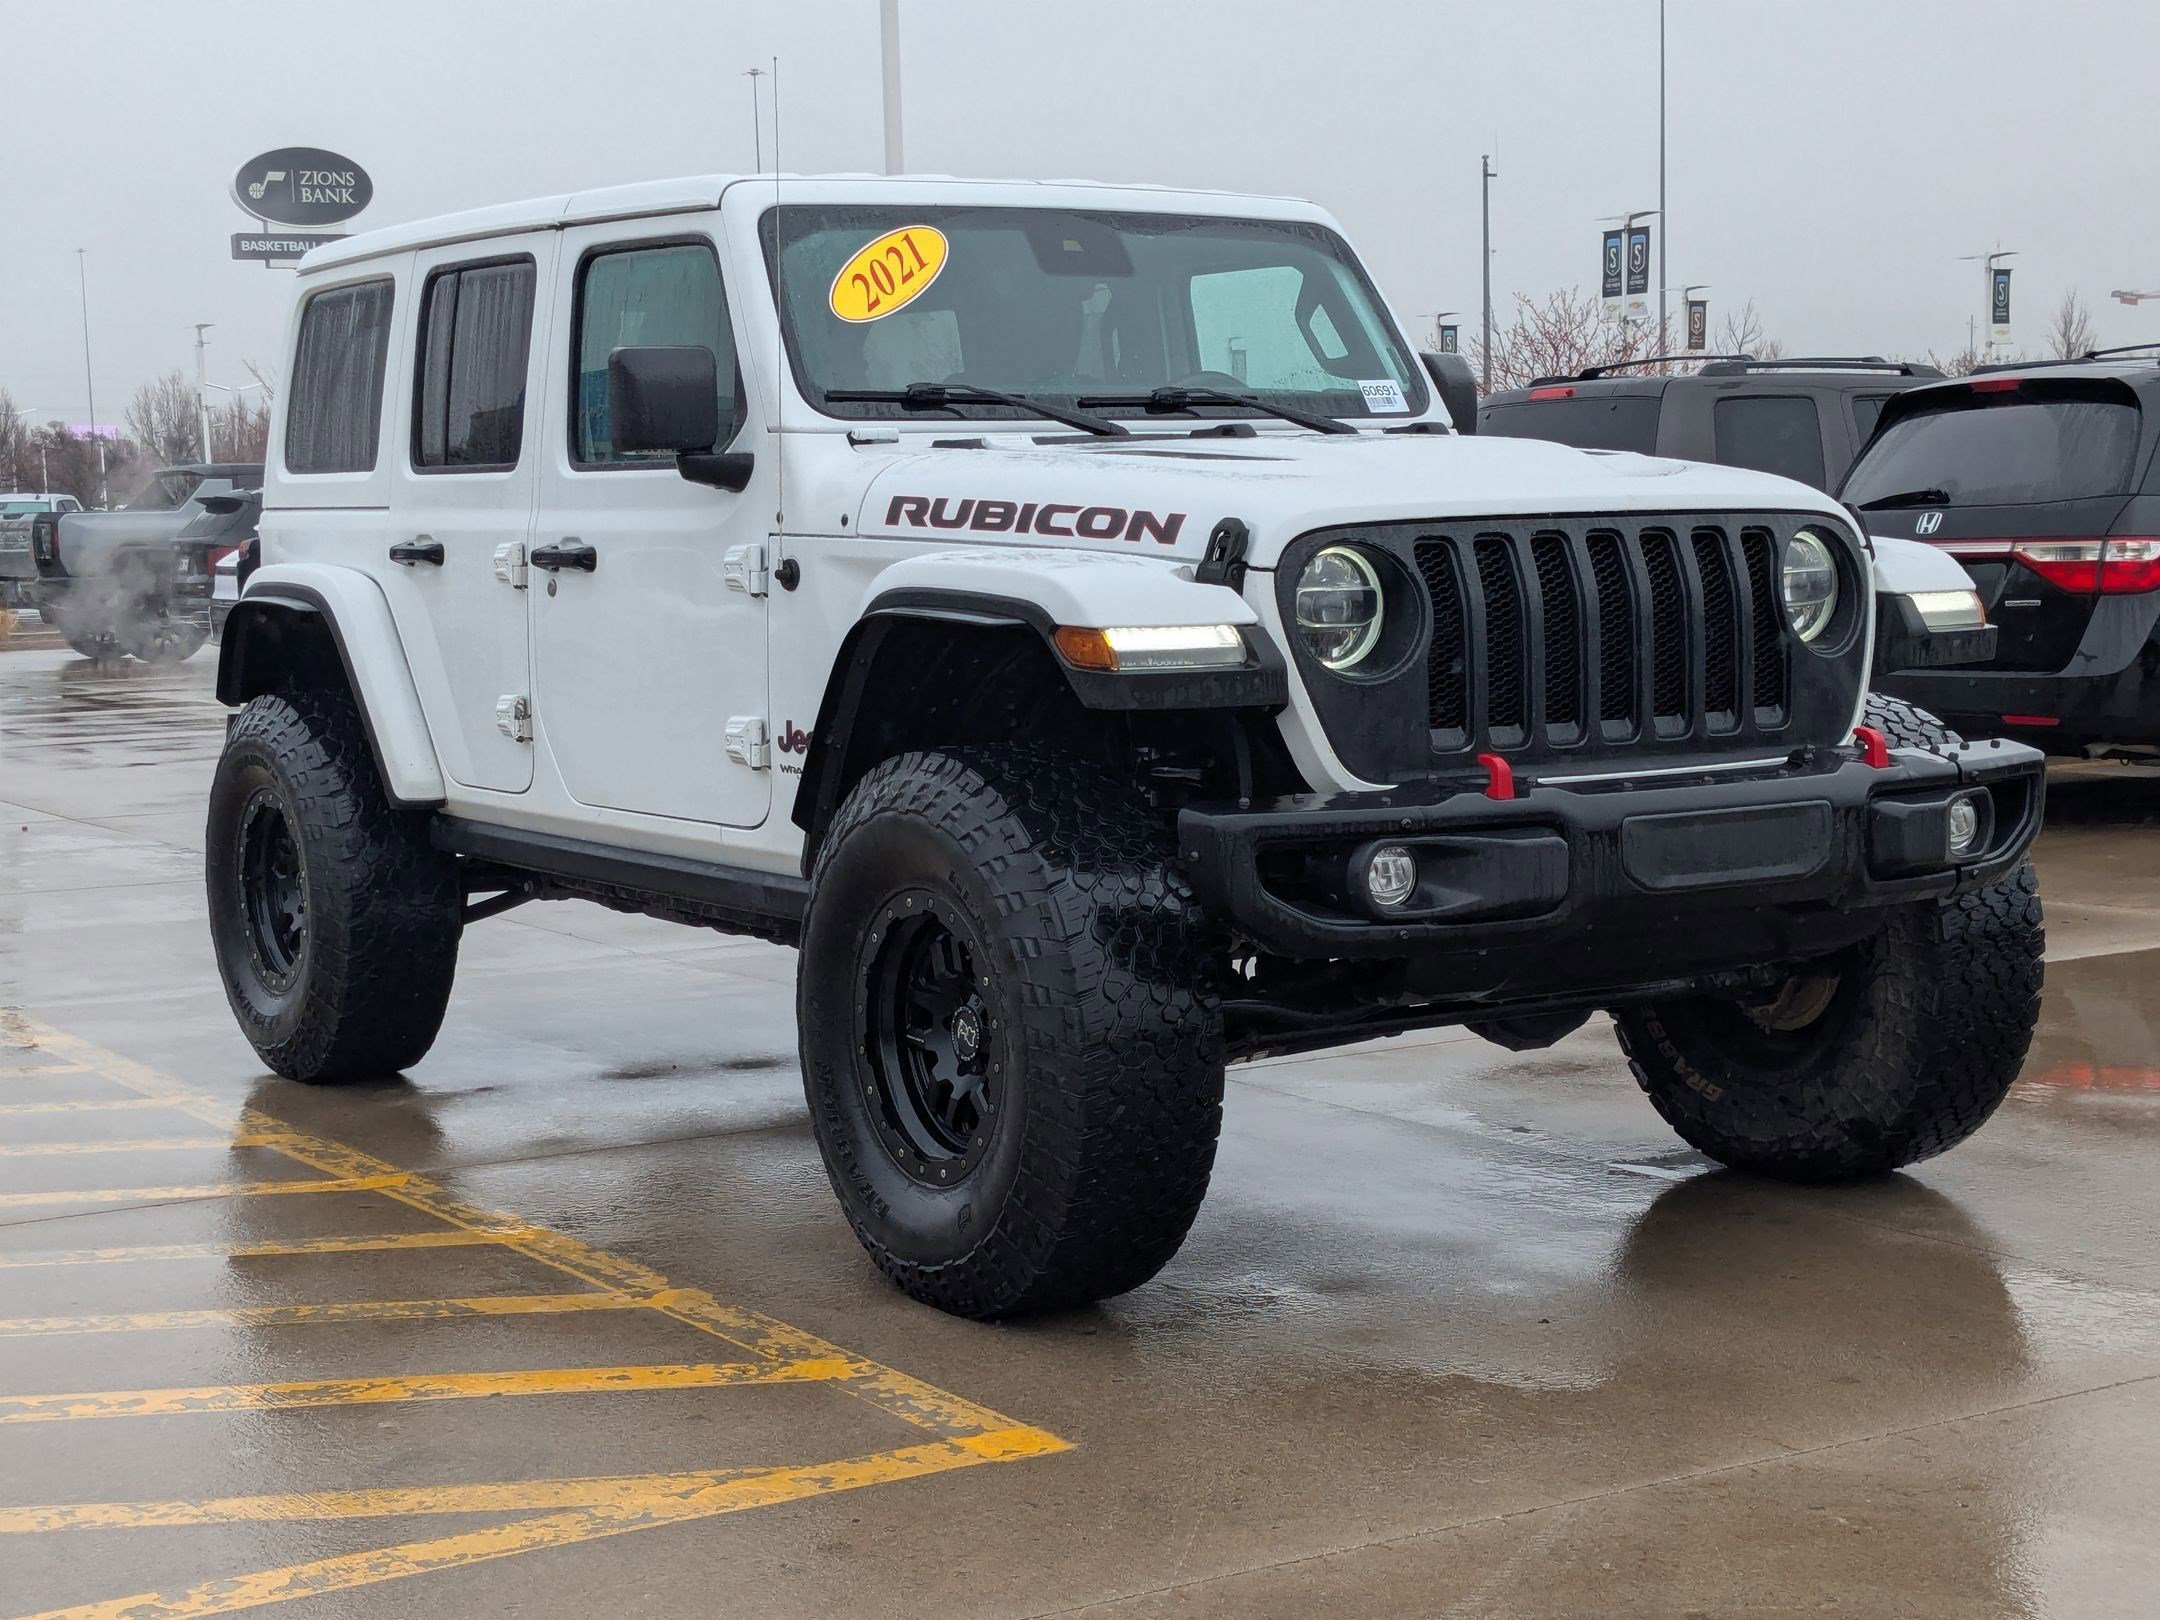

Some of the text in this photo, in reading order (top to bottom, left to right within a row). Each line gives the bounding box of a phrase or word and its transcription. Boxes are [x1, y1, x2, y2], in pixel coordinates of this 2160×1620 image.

[300, 171, 355, 186] ZIONS
[301, 188, 359, 204] BANK
[851, 233, 929, 313] 2021
[1362, 385, 1399, 397] 60691
[884, 495, 1188, 546] RUBICON
[777, 720, 814, 755] Je
